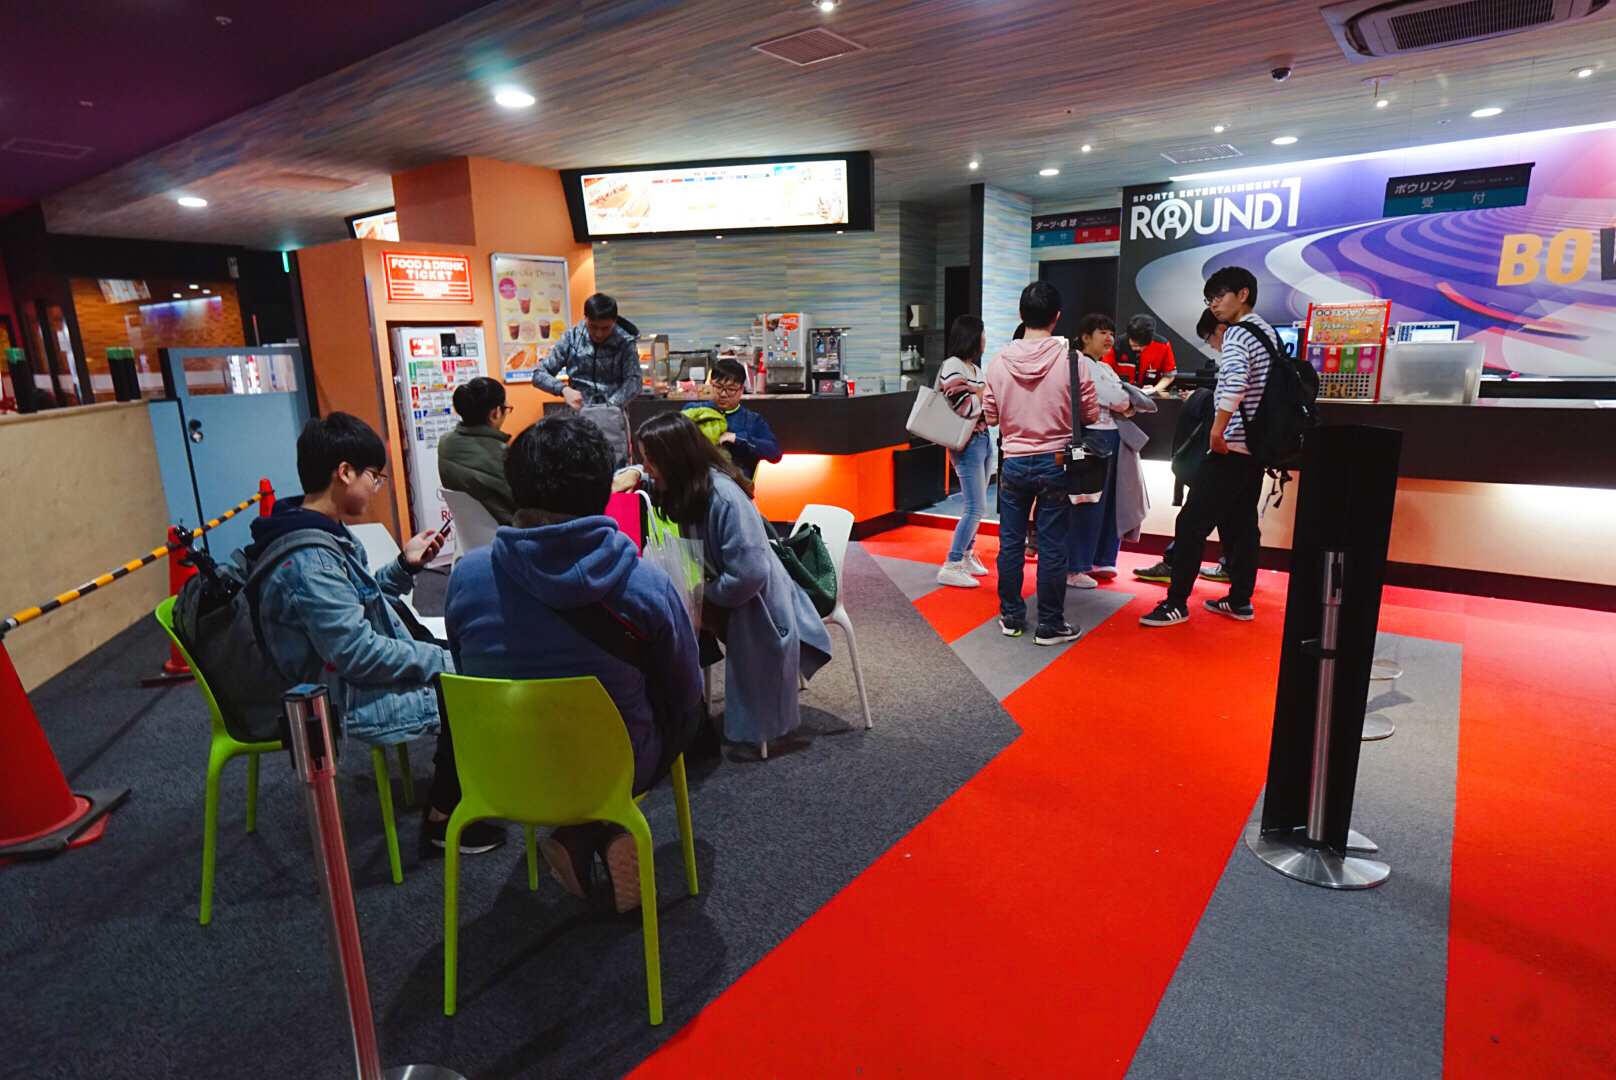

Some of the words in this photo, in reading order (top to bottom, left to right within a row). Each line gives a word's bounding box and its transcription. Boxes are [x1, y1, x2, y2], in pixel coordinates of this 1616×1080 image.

[1132, 191, 1175, 203] SPORTS
[1179, 180, 1281, 198] ENTERTAINMENT
[1394, 178, 1456, 194] ボウリング
[391, 258, 422, 269] FOOD
[423, 260, 431, 270] &
[432, 260, 464, 271] DRINK
[406, 269, 453, 280] TICKET
